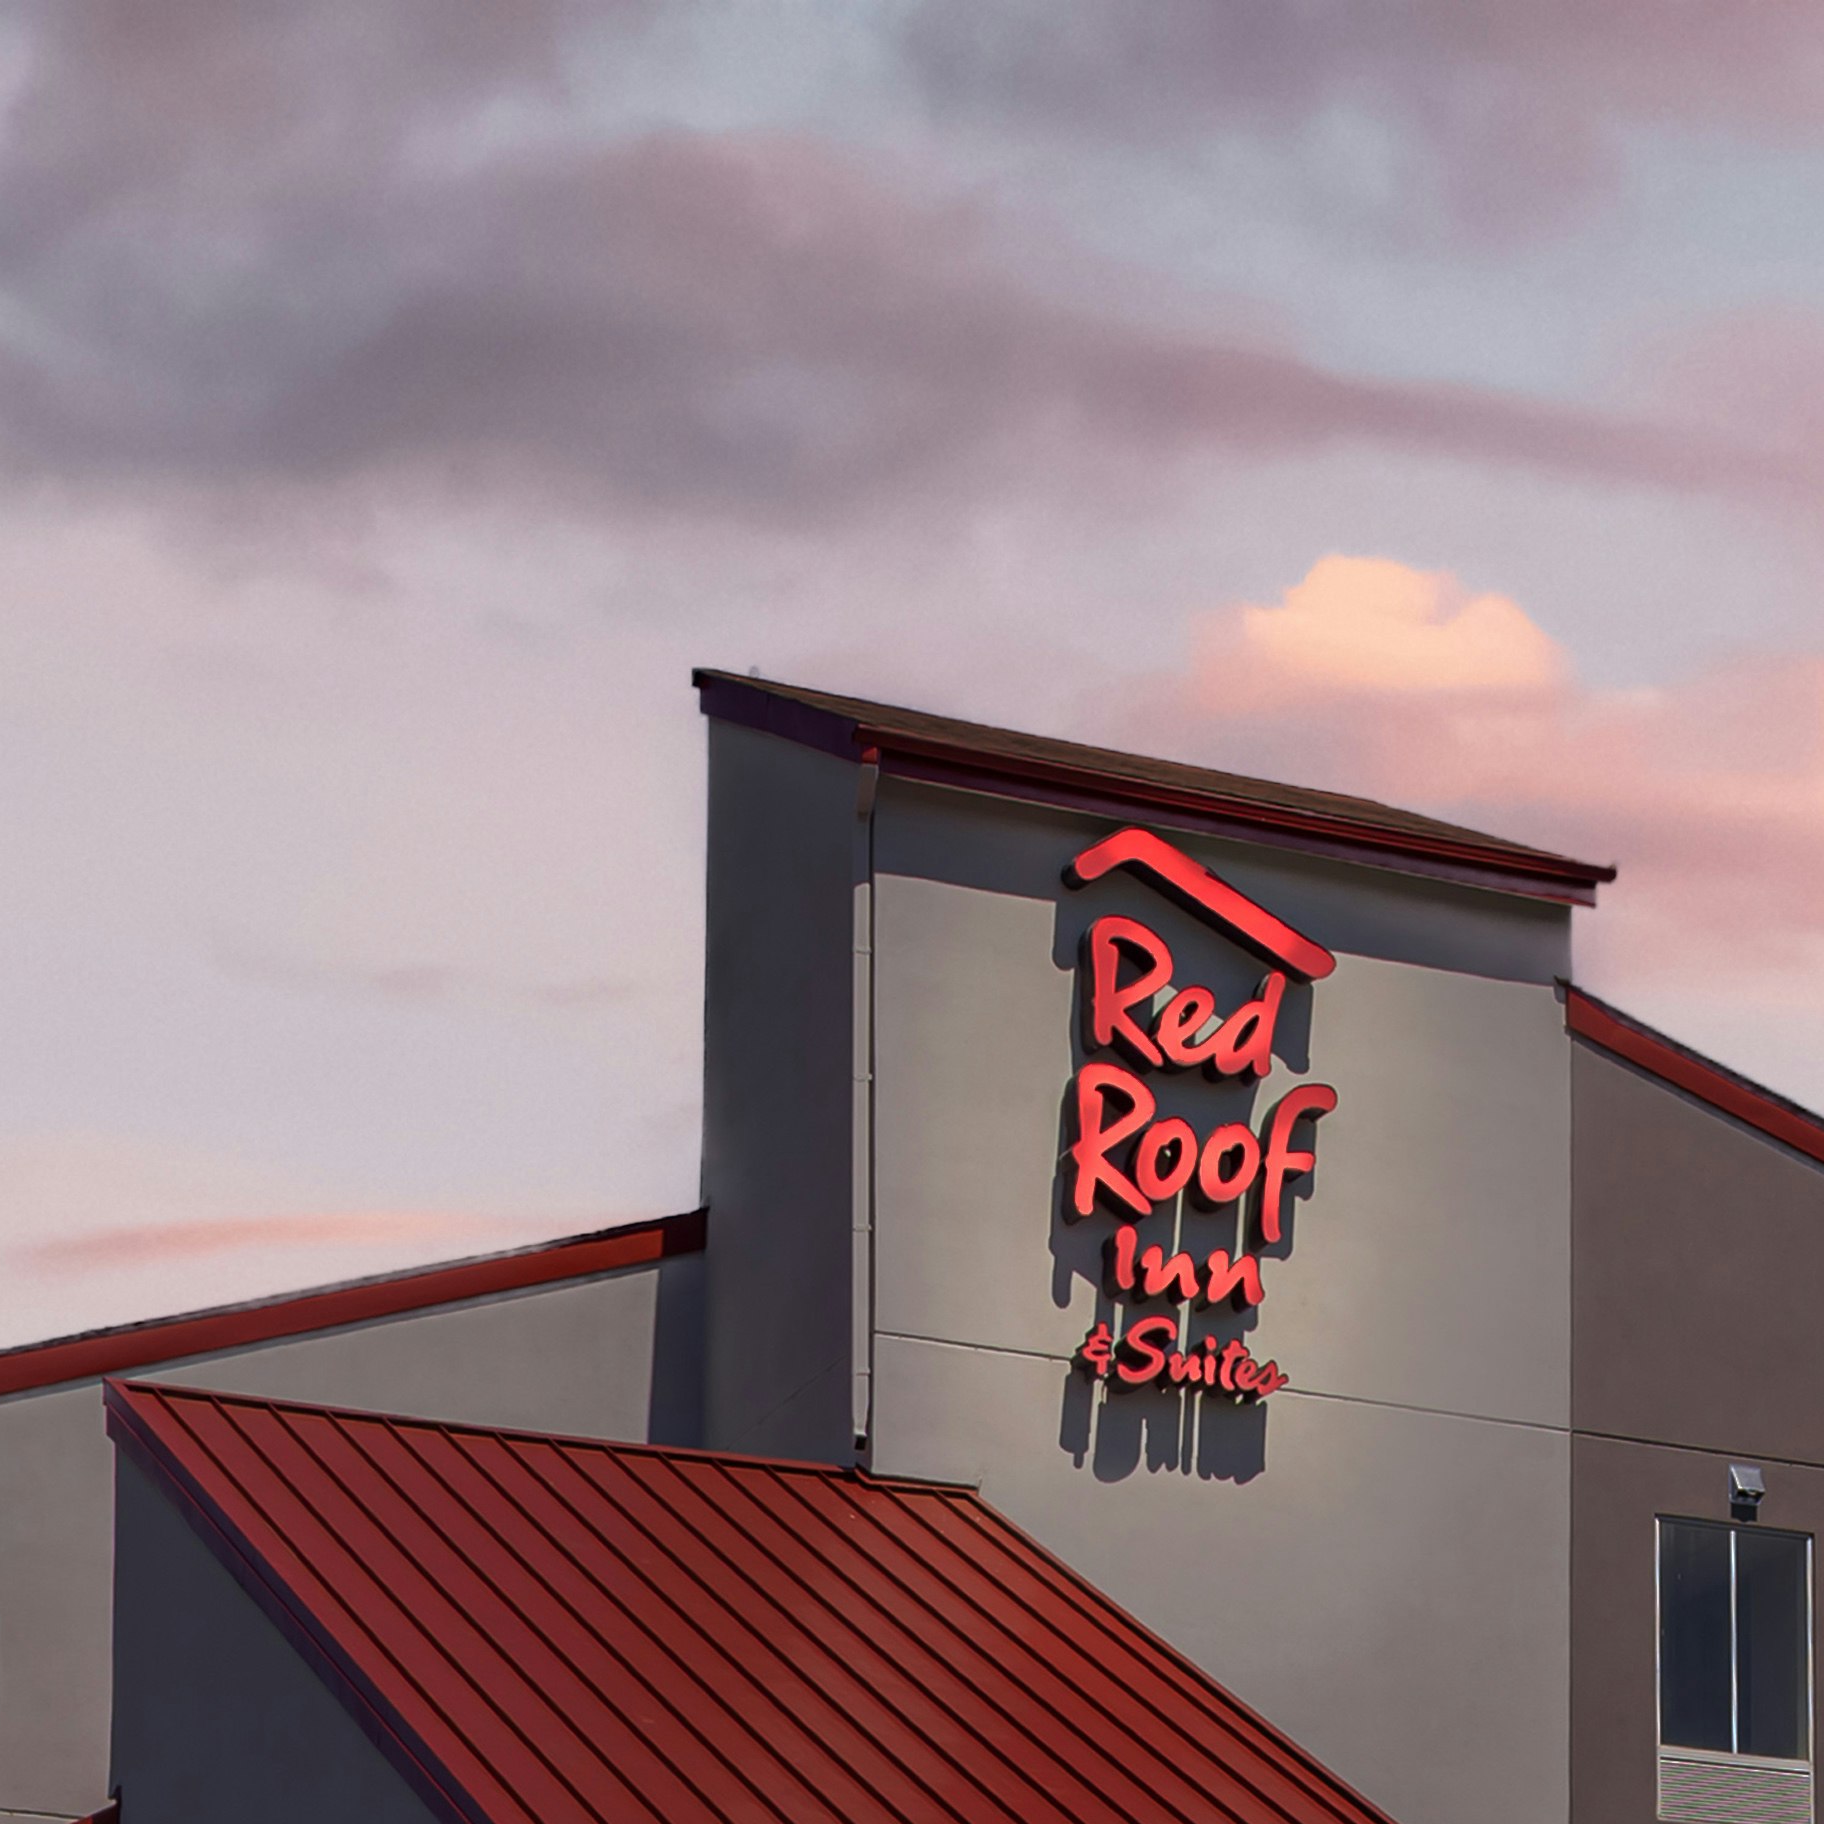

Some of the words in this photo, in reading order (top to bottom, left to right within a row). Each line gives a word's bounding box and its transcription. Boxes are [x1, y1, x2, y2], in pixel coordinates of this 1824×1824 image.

[1090, 915, 1286, 1079] Red
[1072, 1061, 1338, 1244] Roof
[1112, 1223, 1264, 1306] Inn
